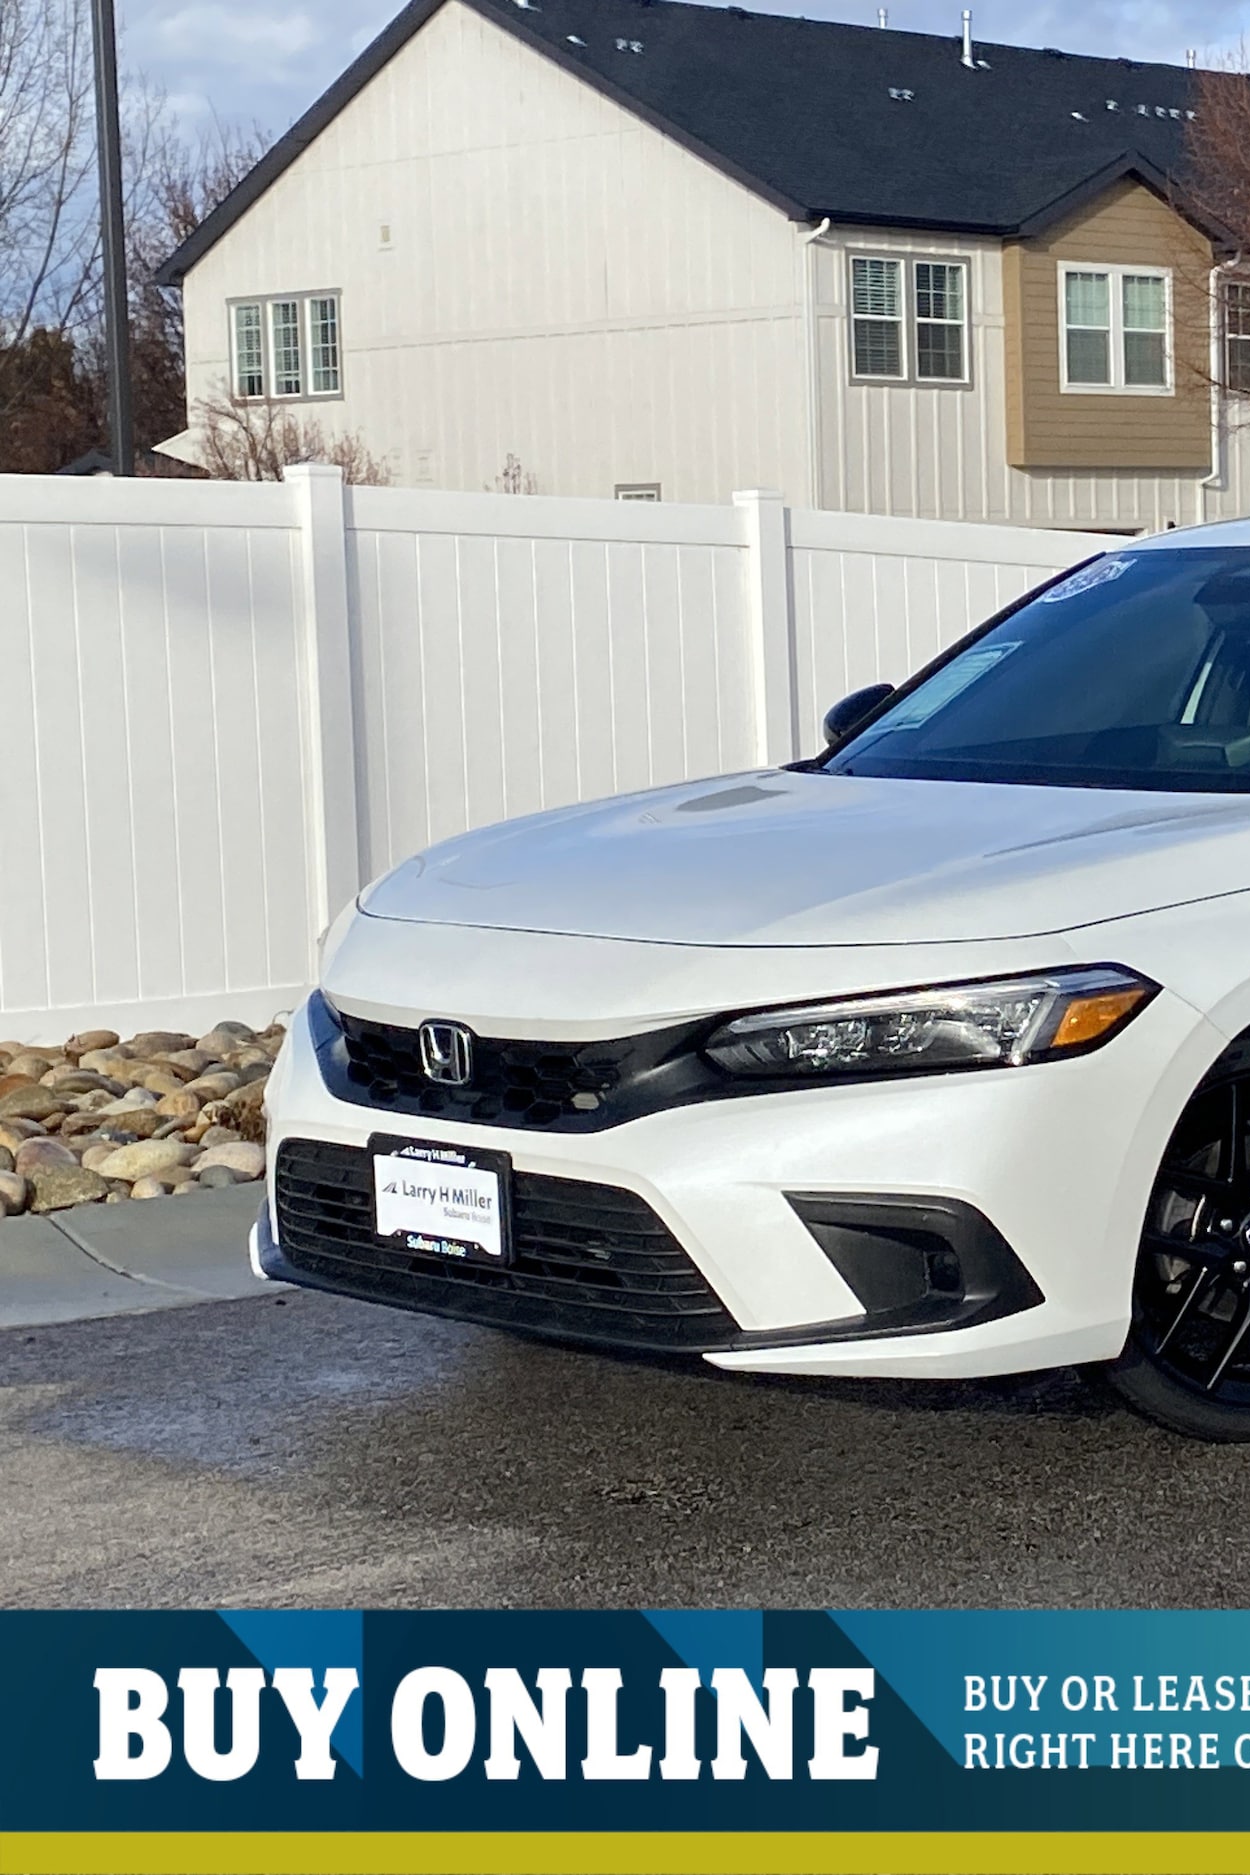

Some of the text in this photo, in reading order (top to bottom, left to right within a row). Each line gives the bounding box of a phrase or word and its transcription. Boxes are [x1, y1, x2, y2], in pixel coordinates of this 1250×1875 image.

[402, 1180, 492, 1210] Larry H Miller
[406, 1234, 466, 1257] Subaru Boise
